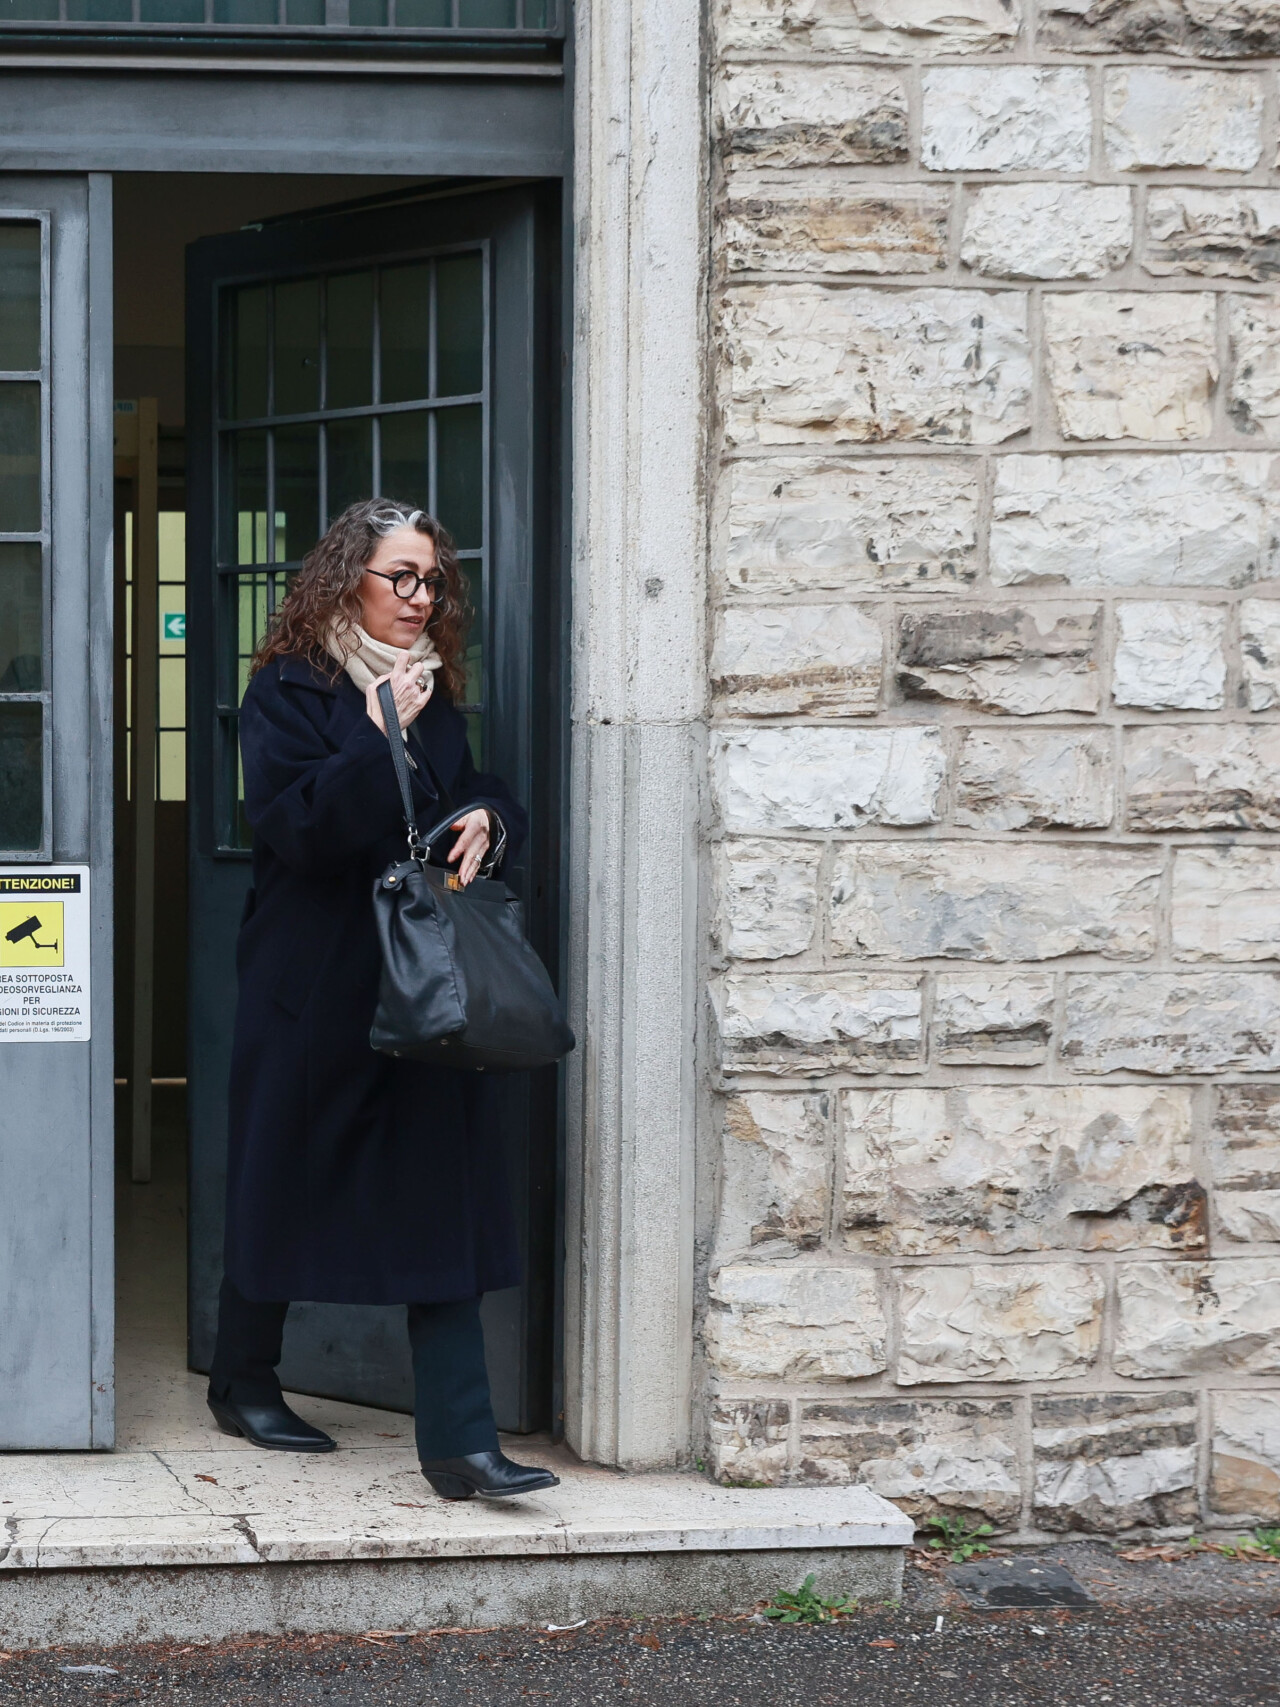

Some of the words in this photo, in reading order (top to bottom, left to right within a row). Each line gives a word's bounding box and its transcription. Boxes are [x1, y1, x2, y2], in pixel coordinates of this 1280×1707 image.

[15, 974, 74, 983] SOTTOPOSTA
[23, 996, 41, 1005] PER
[21, 1007, 30, 1016] DI
[32, 1007, 81, 1016] SICUREZZA
